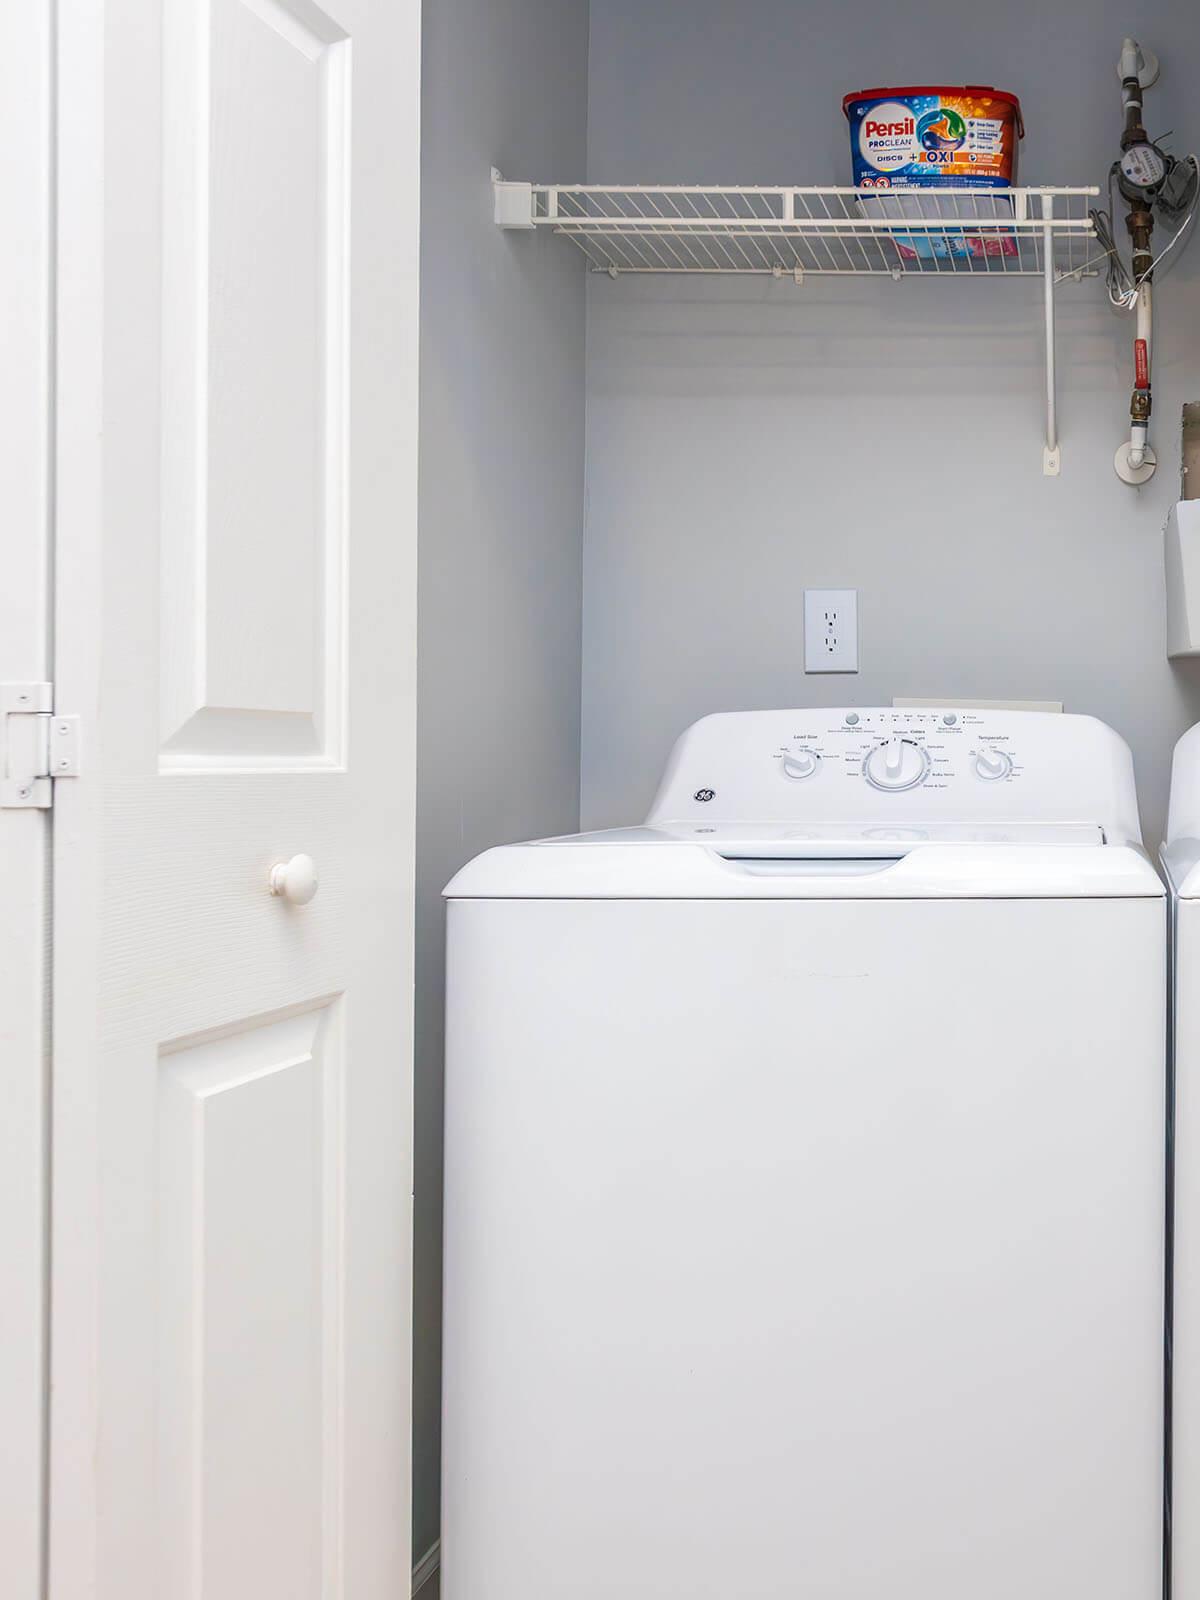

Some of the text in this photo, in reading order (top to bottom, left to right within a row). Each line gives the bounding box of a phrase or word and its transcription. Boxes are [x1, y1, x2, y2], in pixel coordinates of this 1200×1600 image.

[865, 117, 914, 138] Persil
[868, 138, 912, 148] PROCLEAN
[926, 151, 954, 162] OXI
